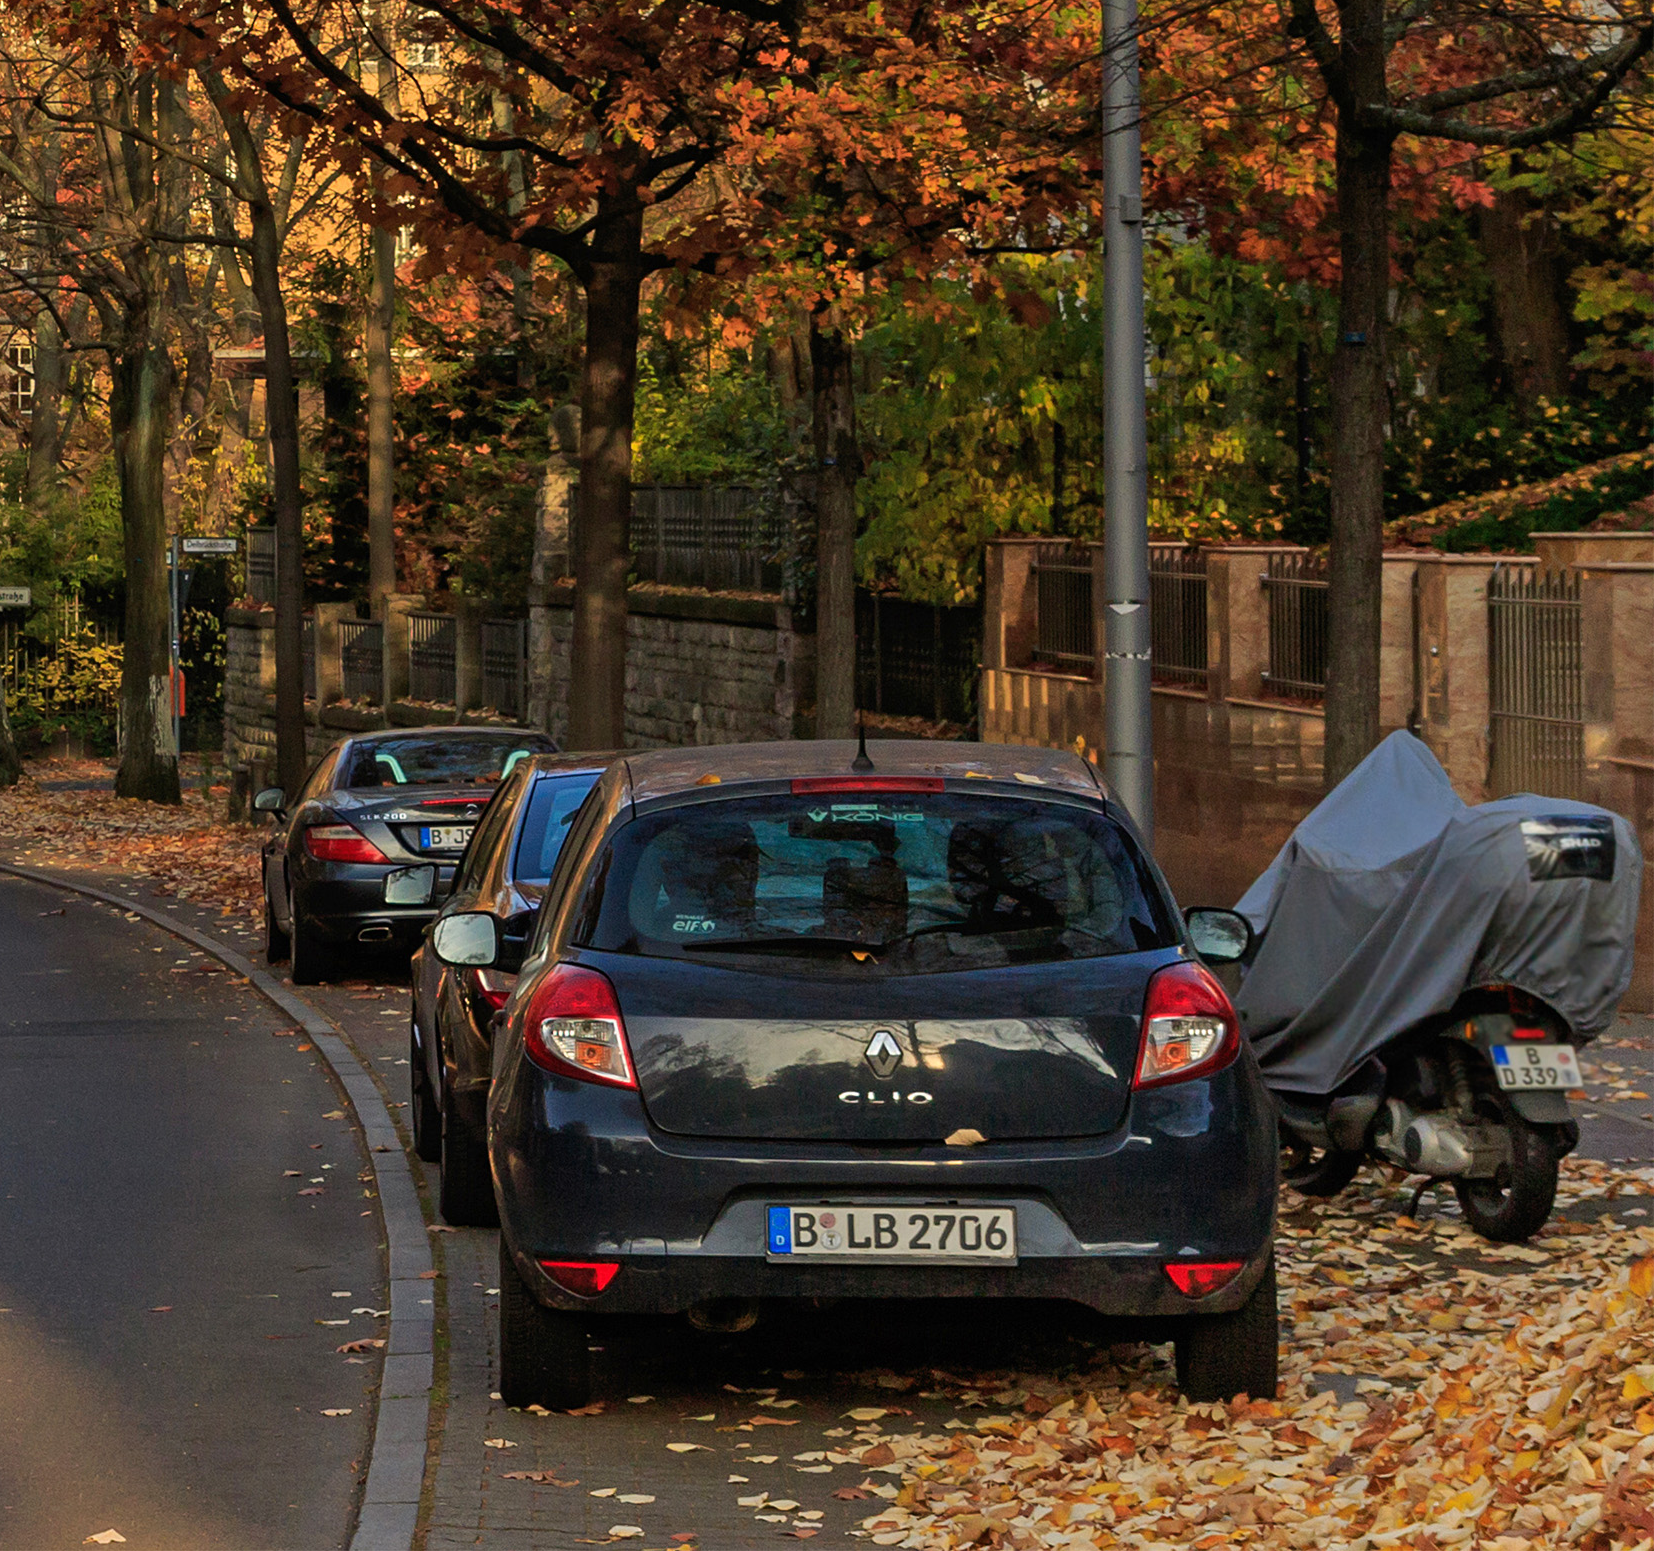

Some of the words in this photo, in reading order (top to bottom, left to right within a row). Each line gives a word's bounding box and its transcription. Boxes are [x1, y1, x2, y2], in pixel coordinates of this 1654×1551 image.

[383, 812, 407, 820] 200
[832, 810, 924, 822] KÖNIG
[431, 829, 442, 845] B
[1560, 837, 1602, 849] SHAD
[672, 920, 700, 932] elf
[1526, 1047, 1541, 1065] B
[1502, 1067, 1517, 1086] D
[1520, 1066, 1558, 1086] 339
[838, 1091, 933, 1104] CLIO
[776, 1235, 786, 1246] D
[793, 1212, 819, 1248] B
[847, 1213, 899, 1249] LB
[908, 1213, 1008, 1250] 2706
